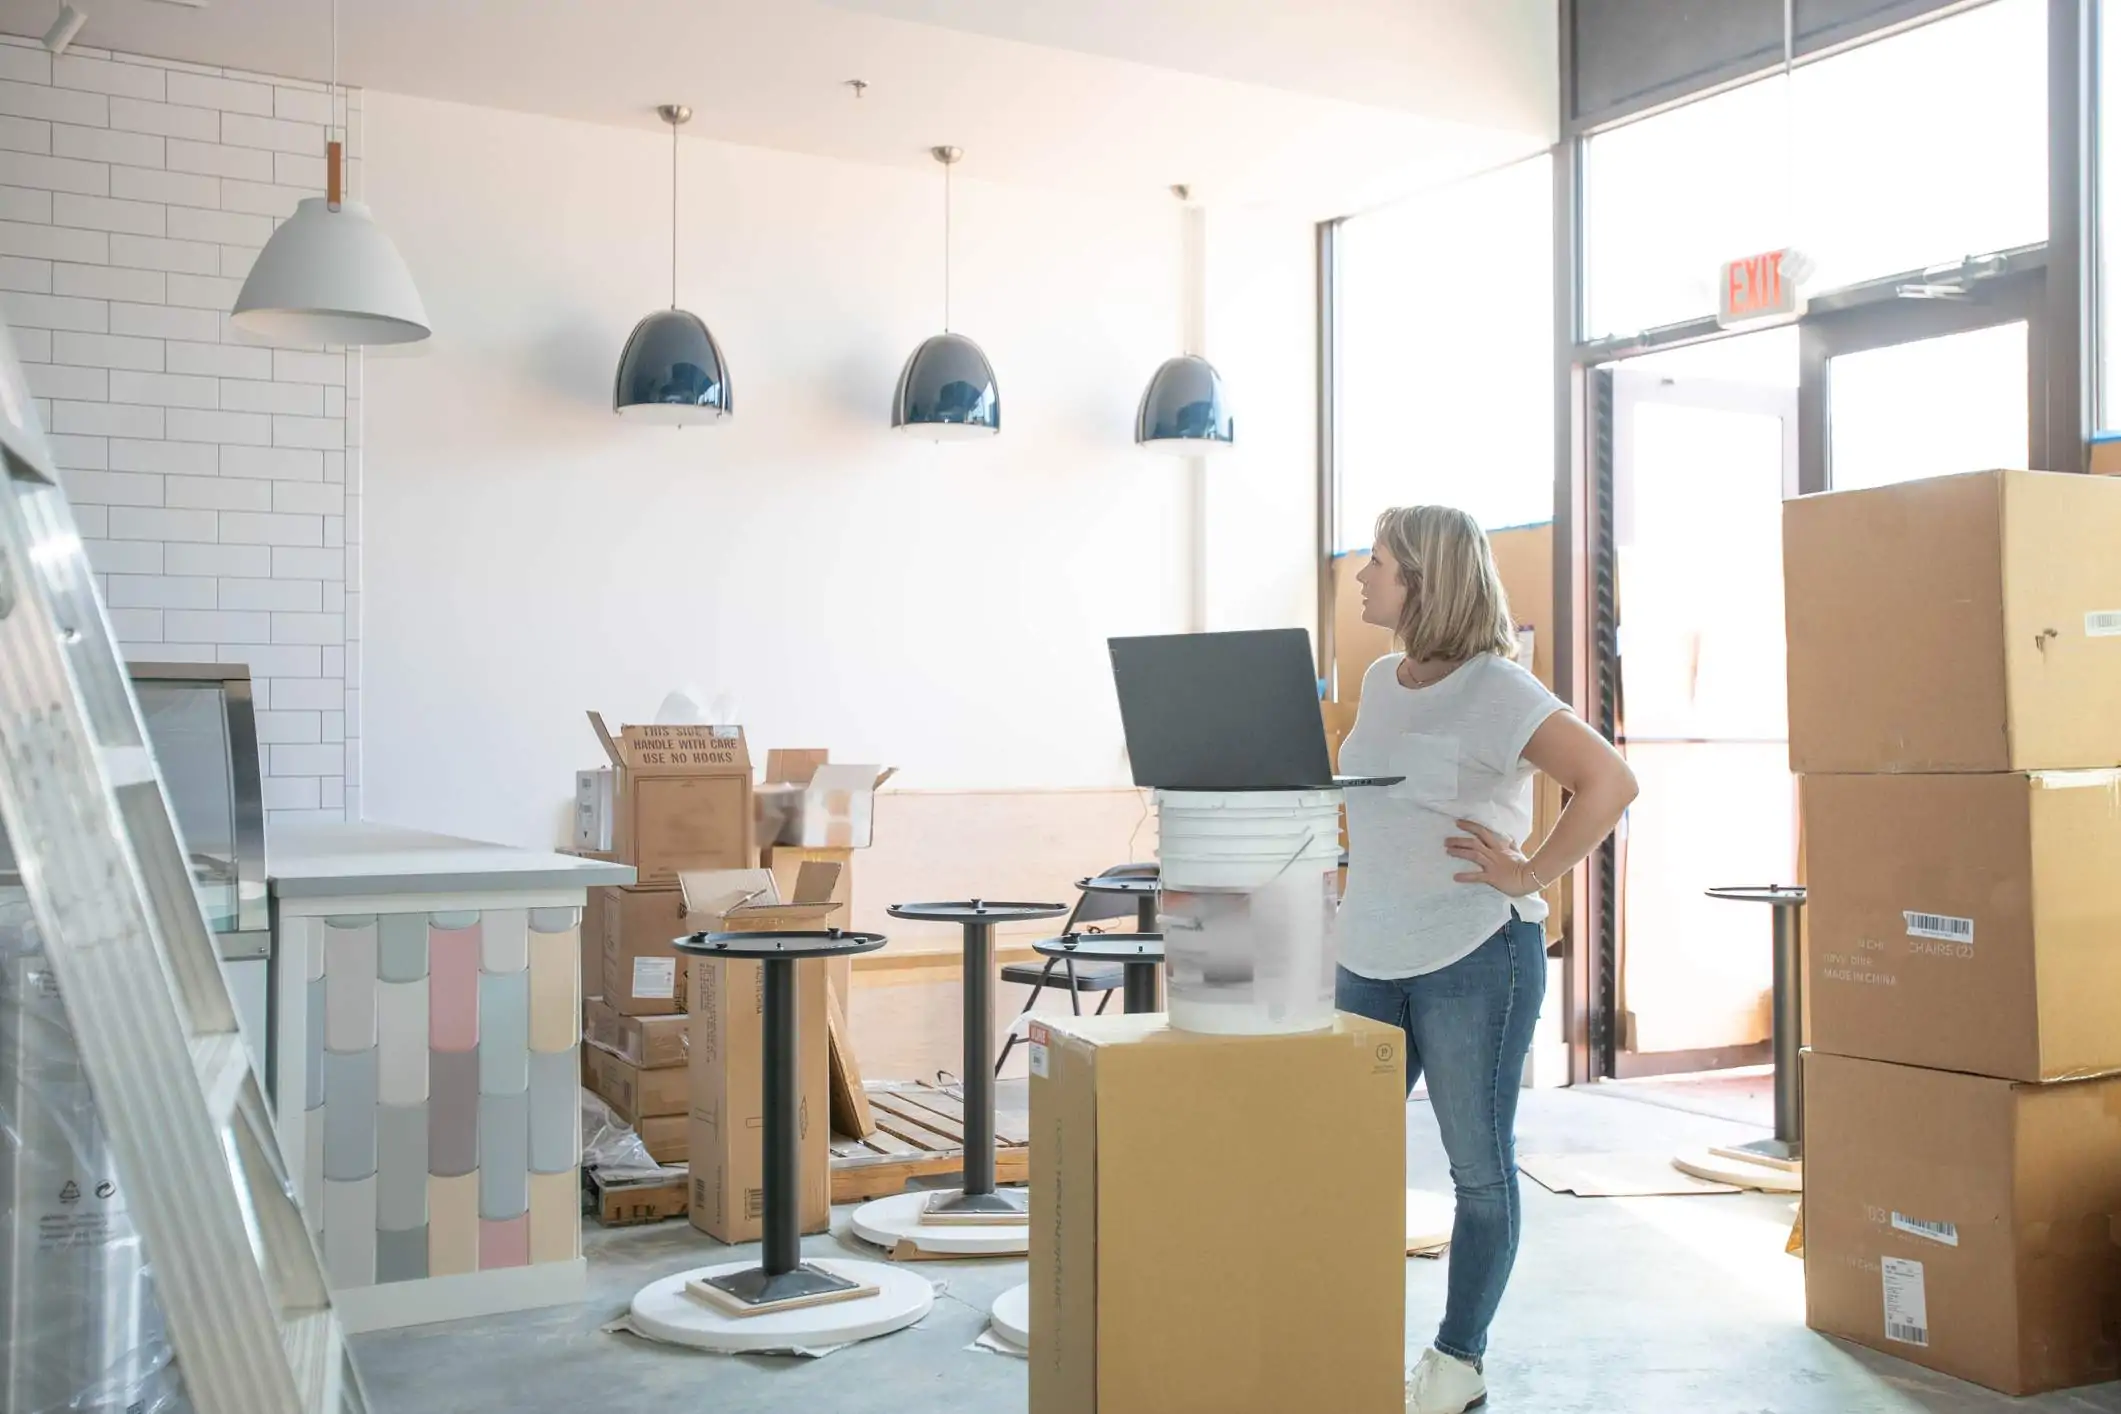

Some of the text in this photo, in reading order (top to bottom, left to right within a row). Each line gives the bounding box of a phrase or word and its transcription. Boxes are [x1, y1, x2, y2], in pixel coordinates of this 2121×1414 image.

[1729, 252, 1782, 314] EXIT
[644, 726, 669, 737] THIS
[633, 739, 737, 750] HANDLE WITH CARE
[642, 752, 733, 764] USE NO HOOKS
[1824, 967, 1851, 981] MADE
[1865, 972, 1897, 986] CHINA
